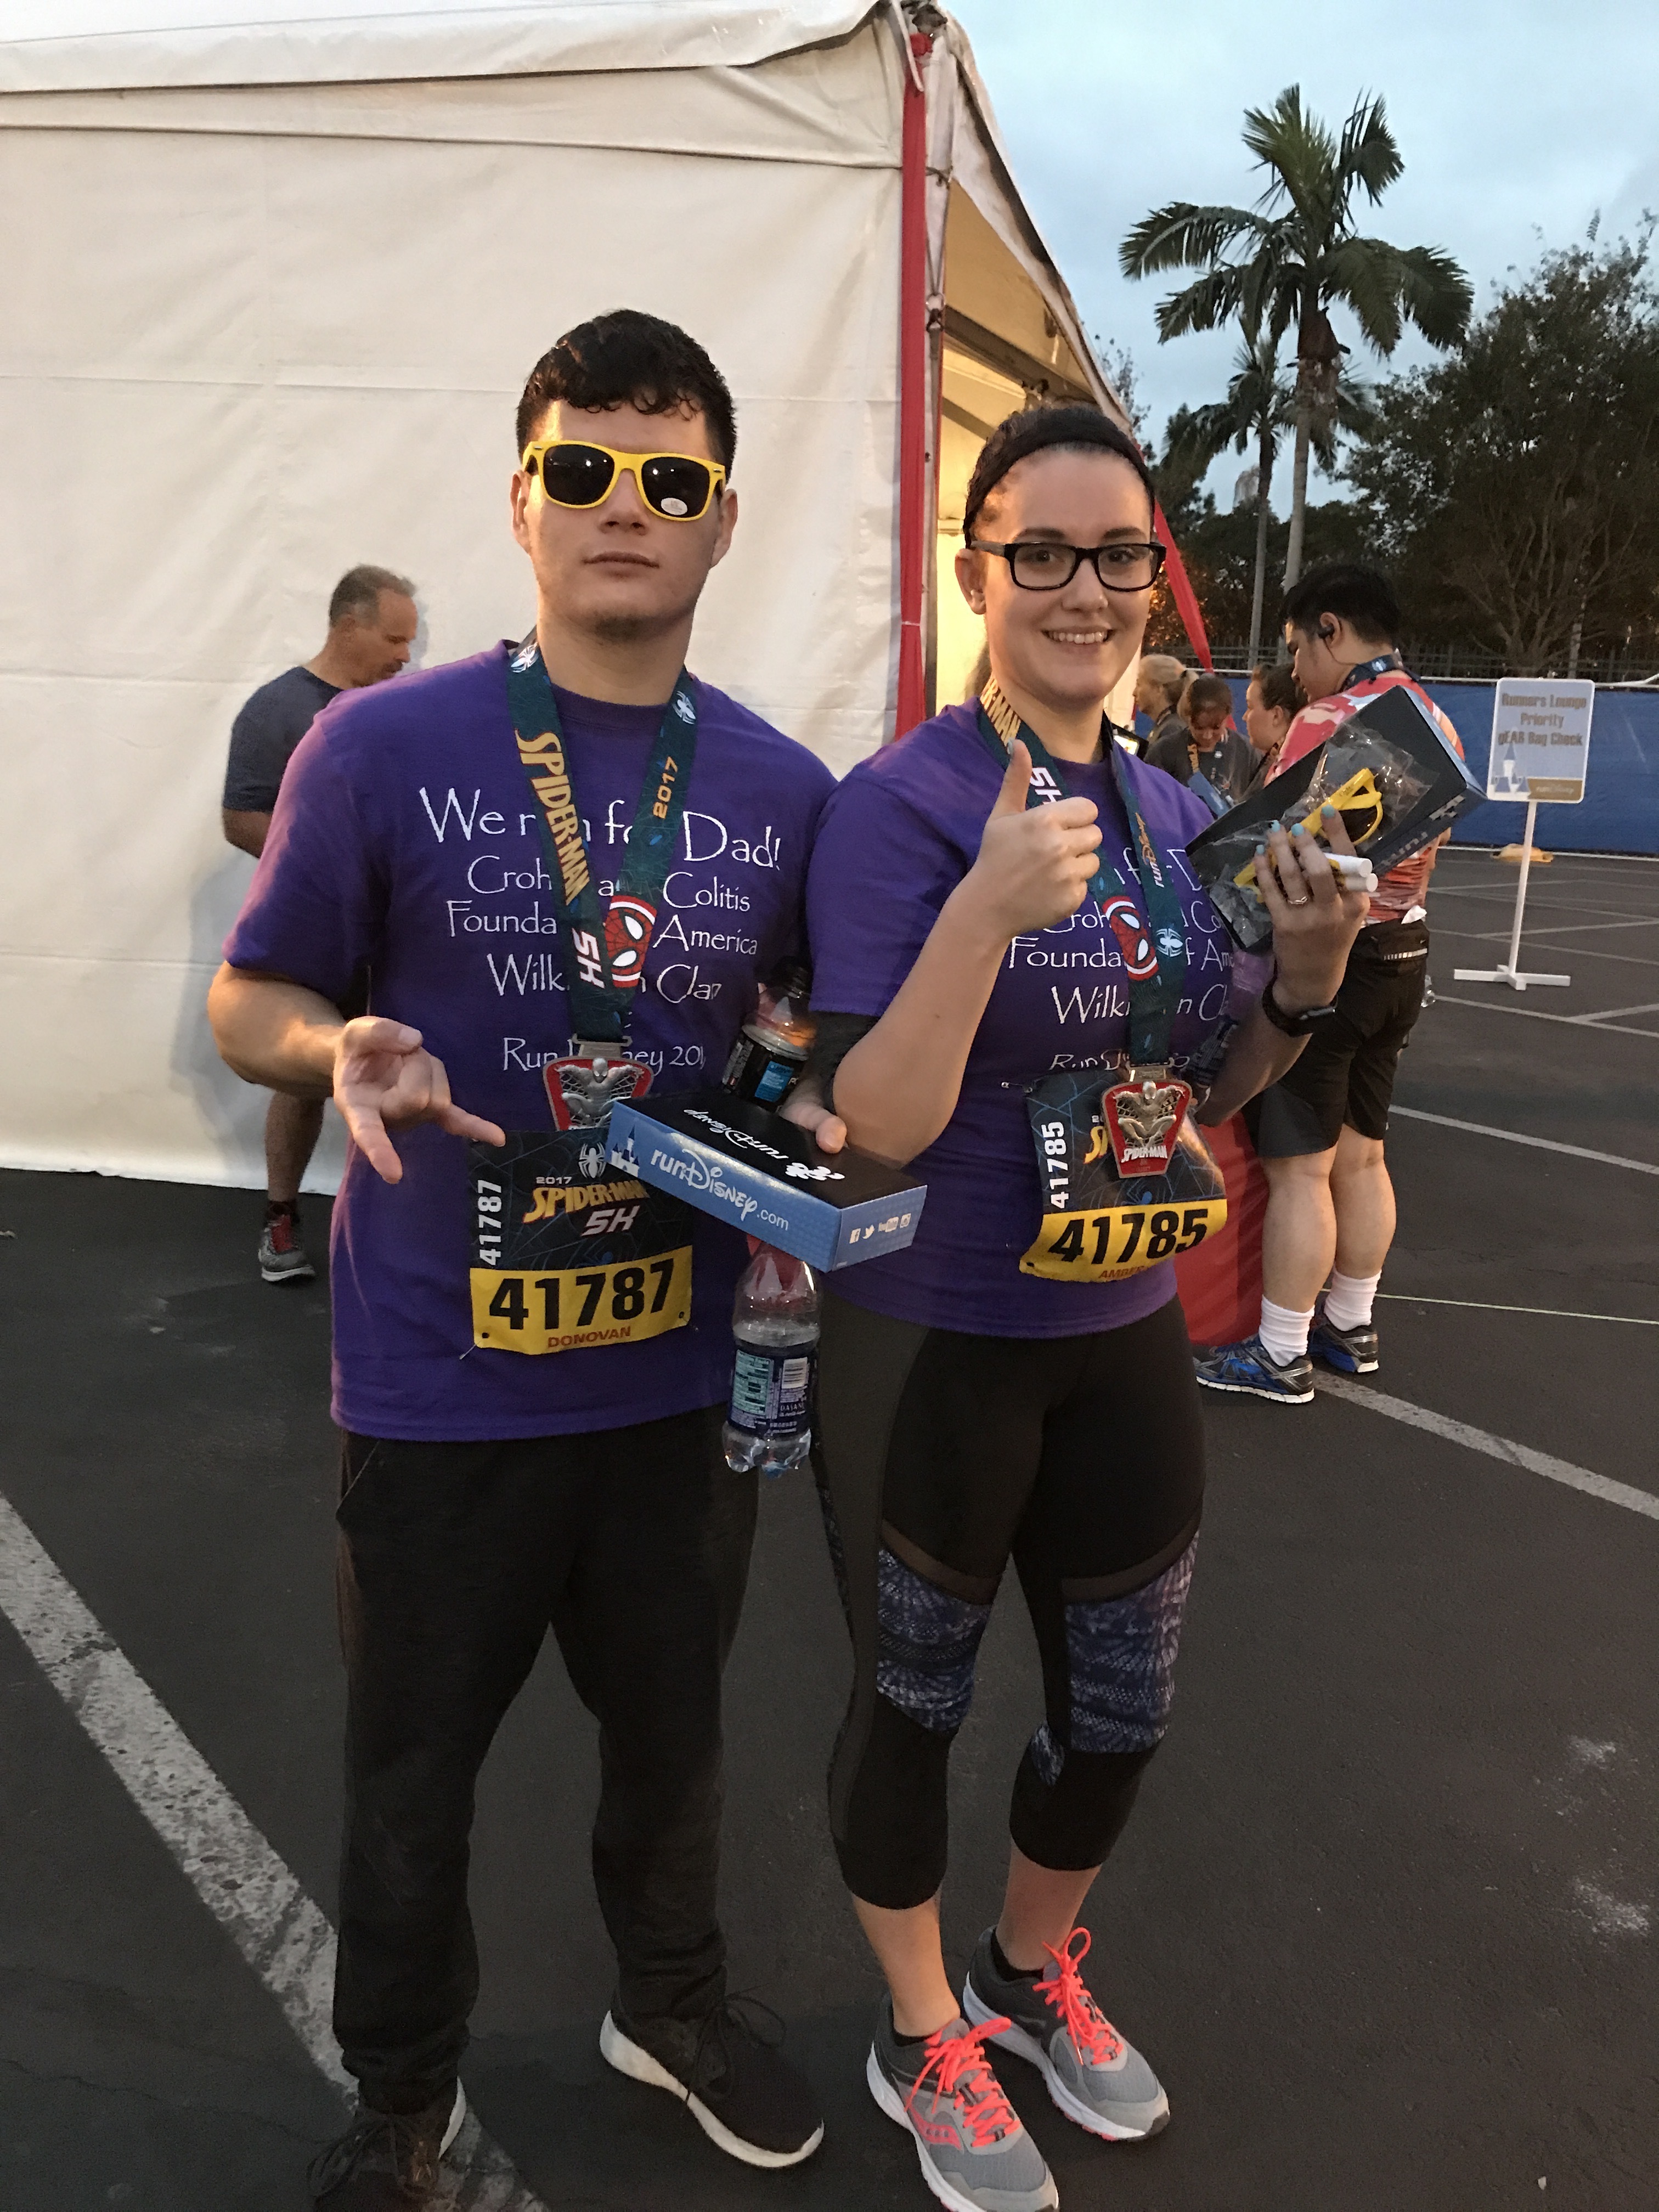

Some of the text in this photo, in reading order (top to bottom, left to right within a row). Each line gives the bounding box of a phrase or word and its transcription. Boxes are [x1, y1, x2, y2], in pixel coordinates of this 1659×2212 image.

[1521, 713, 1564, 728] Priority
[652, 756, 679, 819] 2017
[419, 787, 505, 843] We
[683, 811, 781, 871] Dad!
[515, 729, 590, 905] SPIDER-MAN
[467, 855, 552, 894] Croh
[663, 872, 750, 912] Colitis
[446, 900, 757, 955] Founda America
[1008, 936, 1124, 969] Founda
[504, 1037, 558, 1071] Run
[535, 1176, 572, 1185] 2017
[1041, 1121, 1070, 1209] 41785
[477, 1180, 502, 1266] 41787
[523, 1180, 650, 1223] SPIDER-MAN
[1048, 1209, 1208, 1265] 41785
[489, 1257, 674, 1330] 41787
[548, 1325, 631, 1348] DONOVAN
